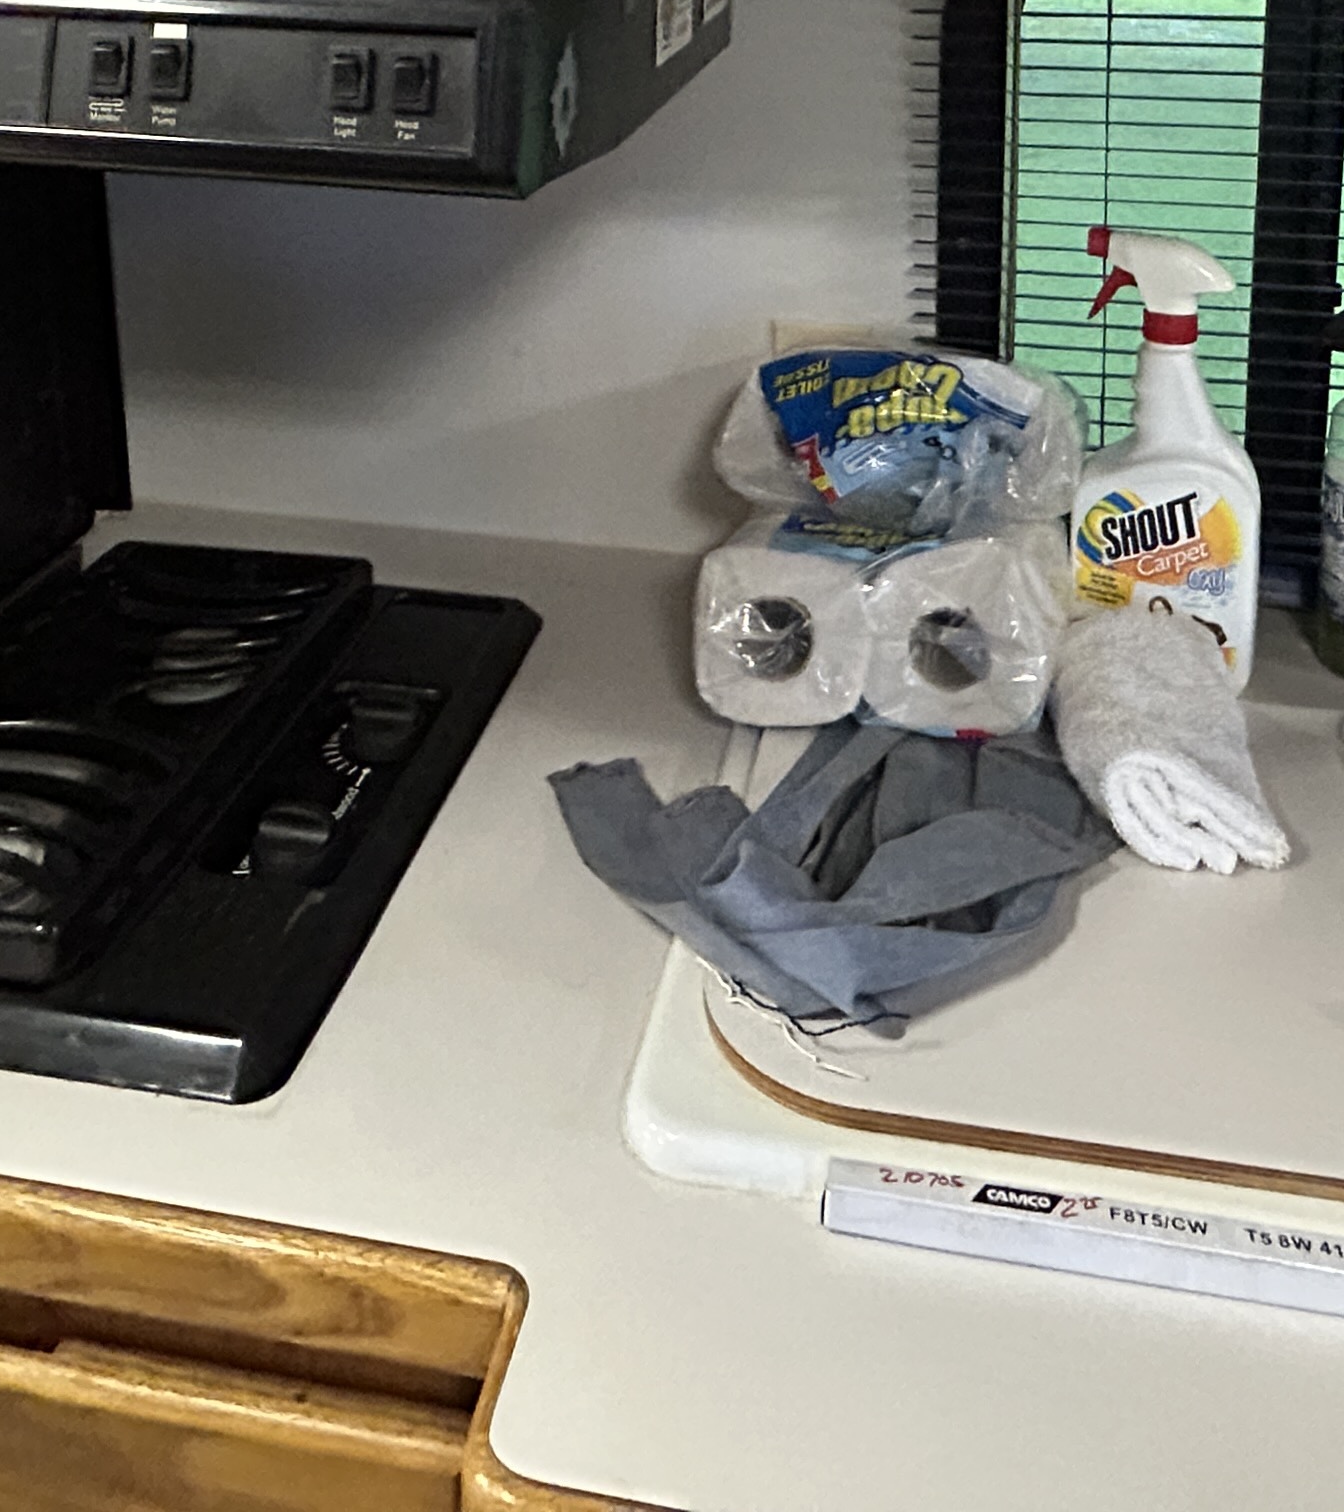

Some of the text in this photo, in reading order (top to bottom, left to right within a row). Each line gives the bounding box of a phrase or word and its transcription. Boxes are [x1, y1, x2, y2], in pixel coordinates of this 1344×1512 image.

[1100, 491, 1198, 561] SHOUT
[1136, 541, 1209, 577] Carpet
[985, 1187, 1052, 1211] CAMCO
[1109, 1206, 1209, 1236] F8T5/CW
[1244, 1227, 1273, 1247] T5
[1277, 1233, 1313, 1253] 8W
